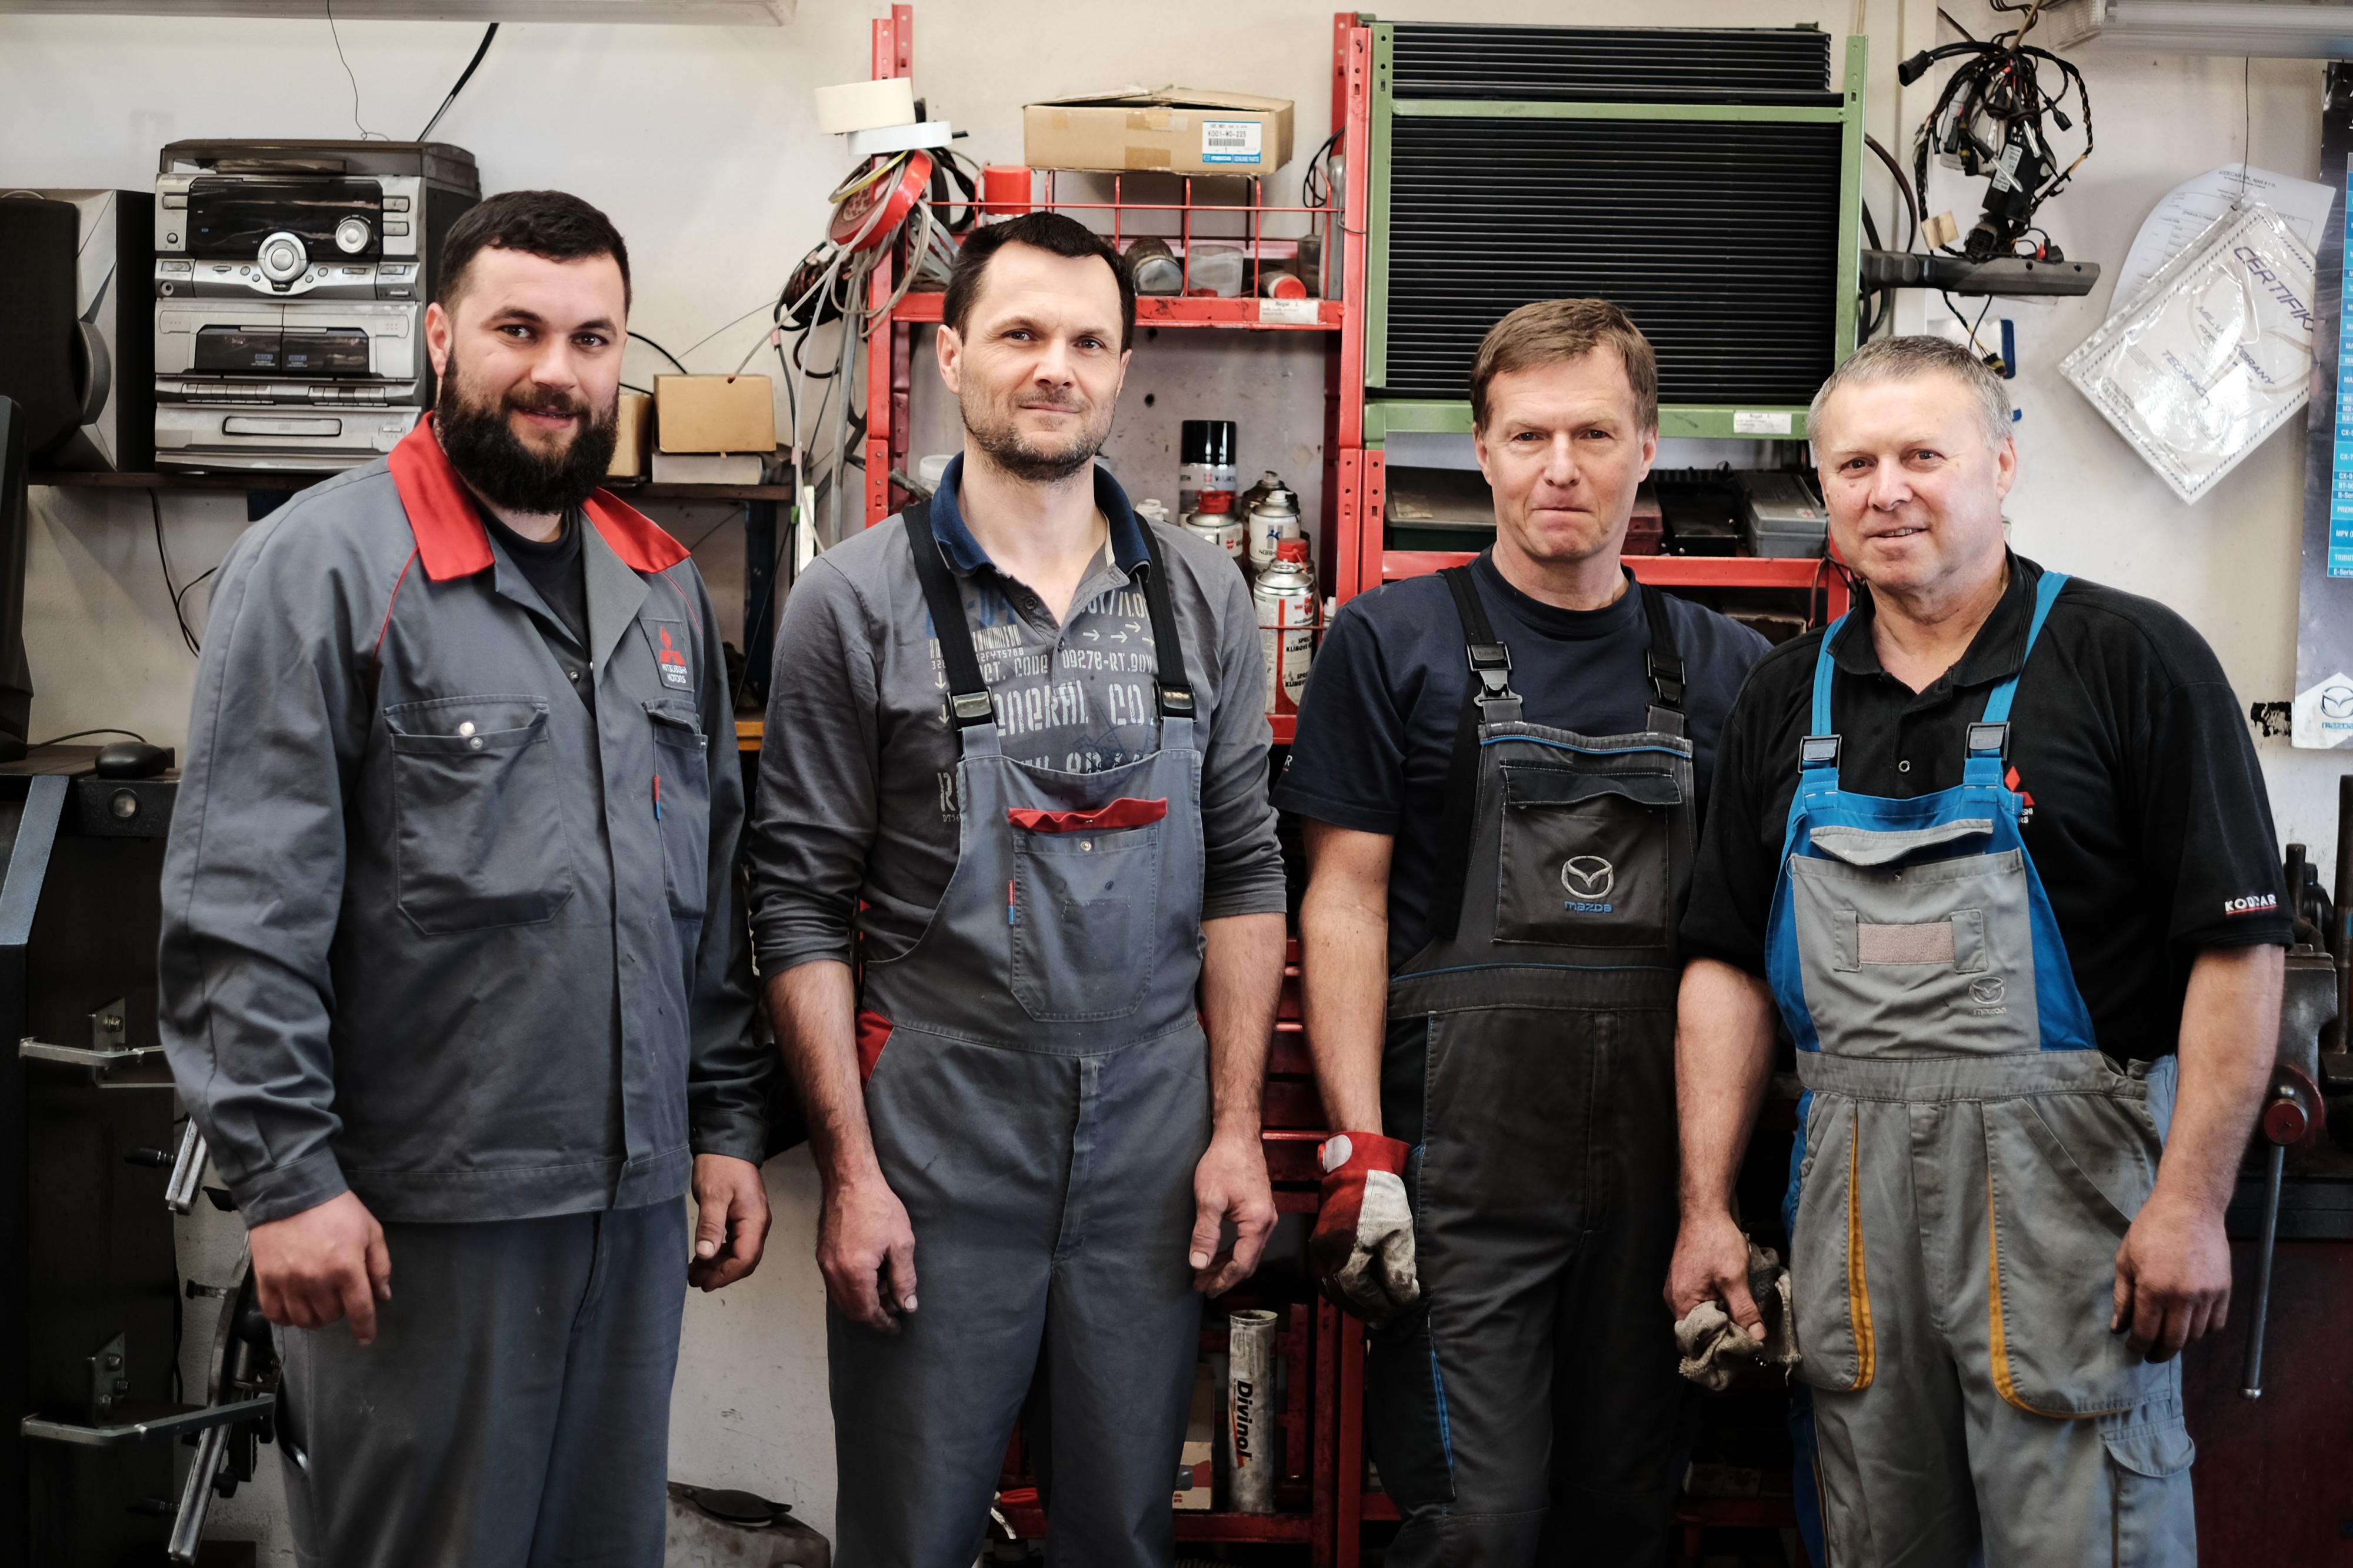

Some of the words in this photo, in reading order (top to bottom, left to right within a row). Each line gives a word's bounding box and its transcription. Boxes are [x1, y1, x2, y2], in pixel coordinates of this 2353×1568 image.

[2234, 246, 2314, 332] CERTIFIK
[1564, 900, 1613, 912] mazda
[1237, 1380, 1253, 1459] Divinol
